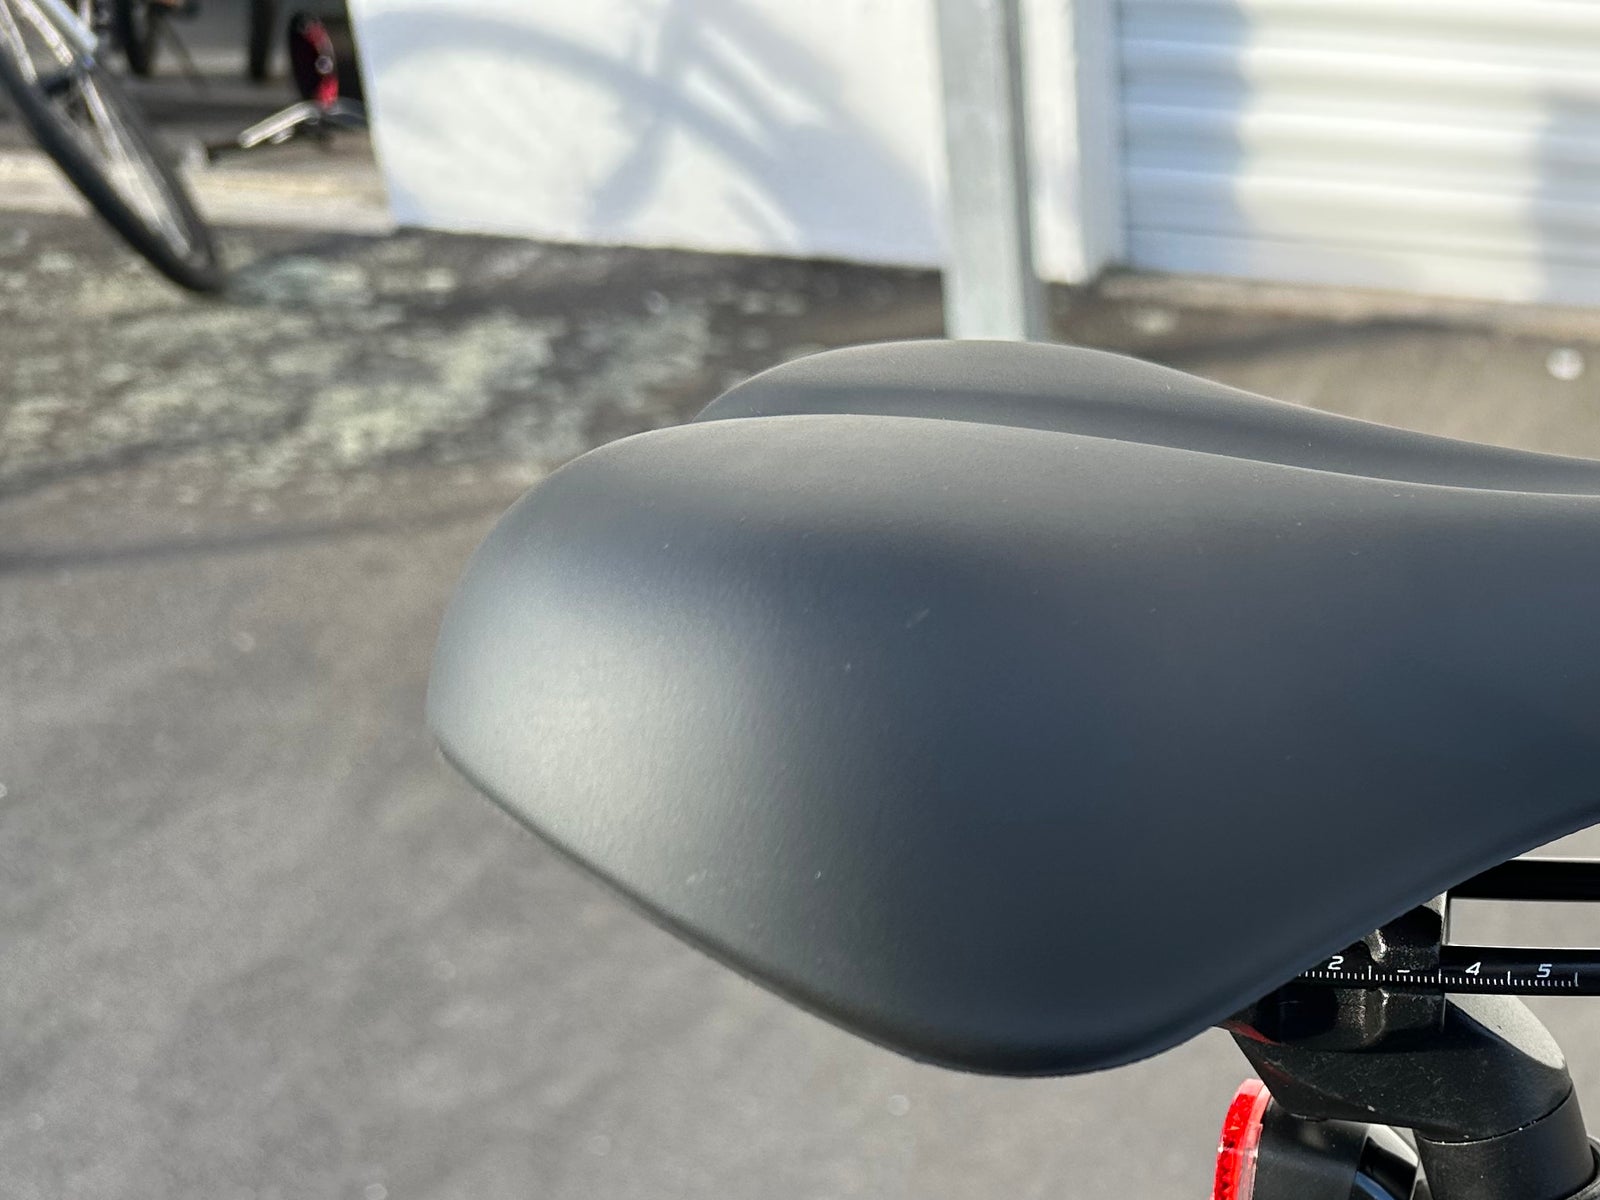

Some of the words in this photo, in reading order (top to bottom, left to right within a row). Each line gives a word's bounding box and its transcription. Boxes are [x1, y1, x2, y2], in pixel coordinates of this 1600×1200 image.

[1327, 955, 1344, 970] 2
[1465, 961, 1481, 976] 4
[1537, 963, 1552, 978] 5
